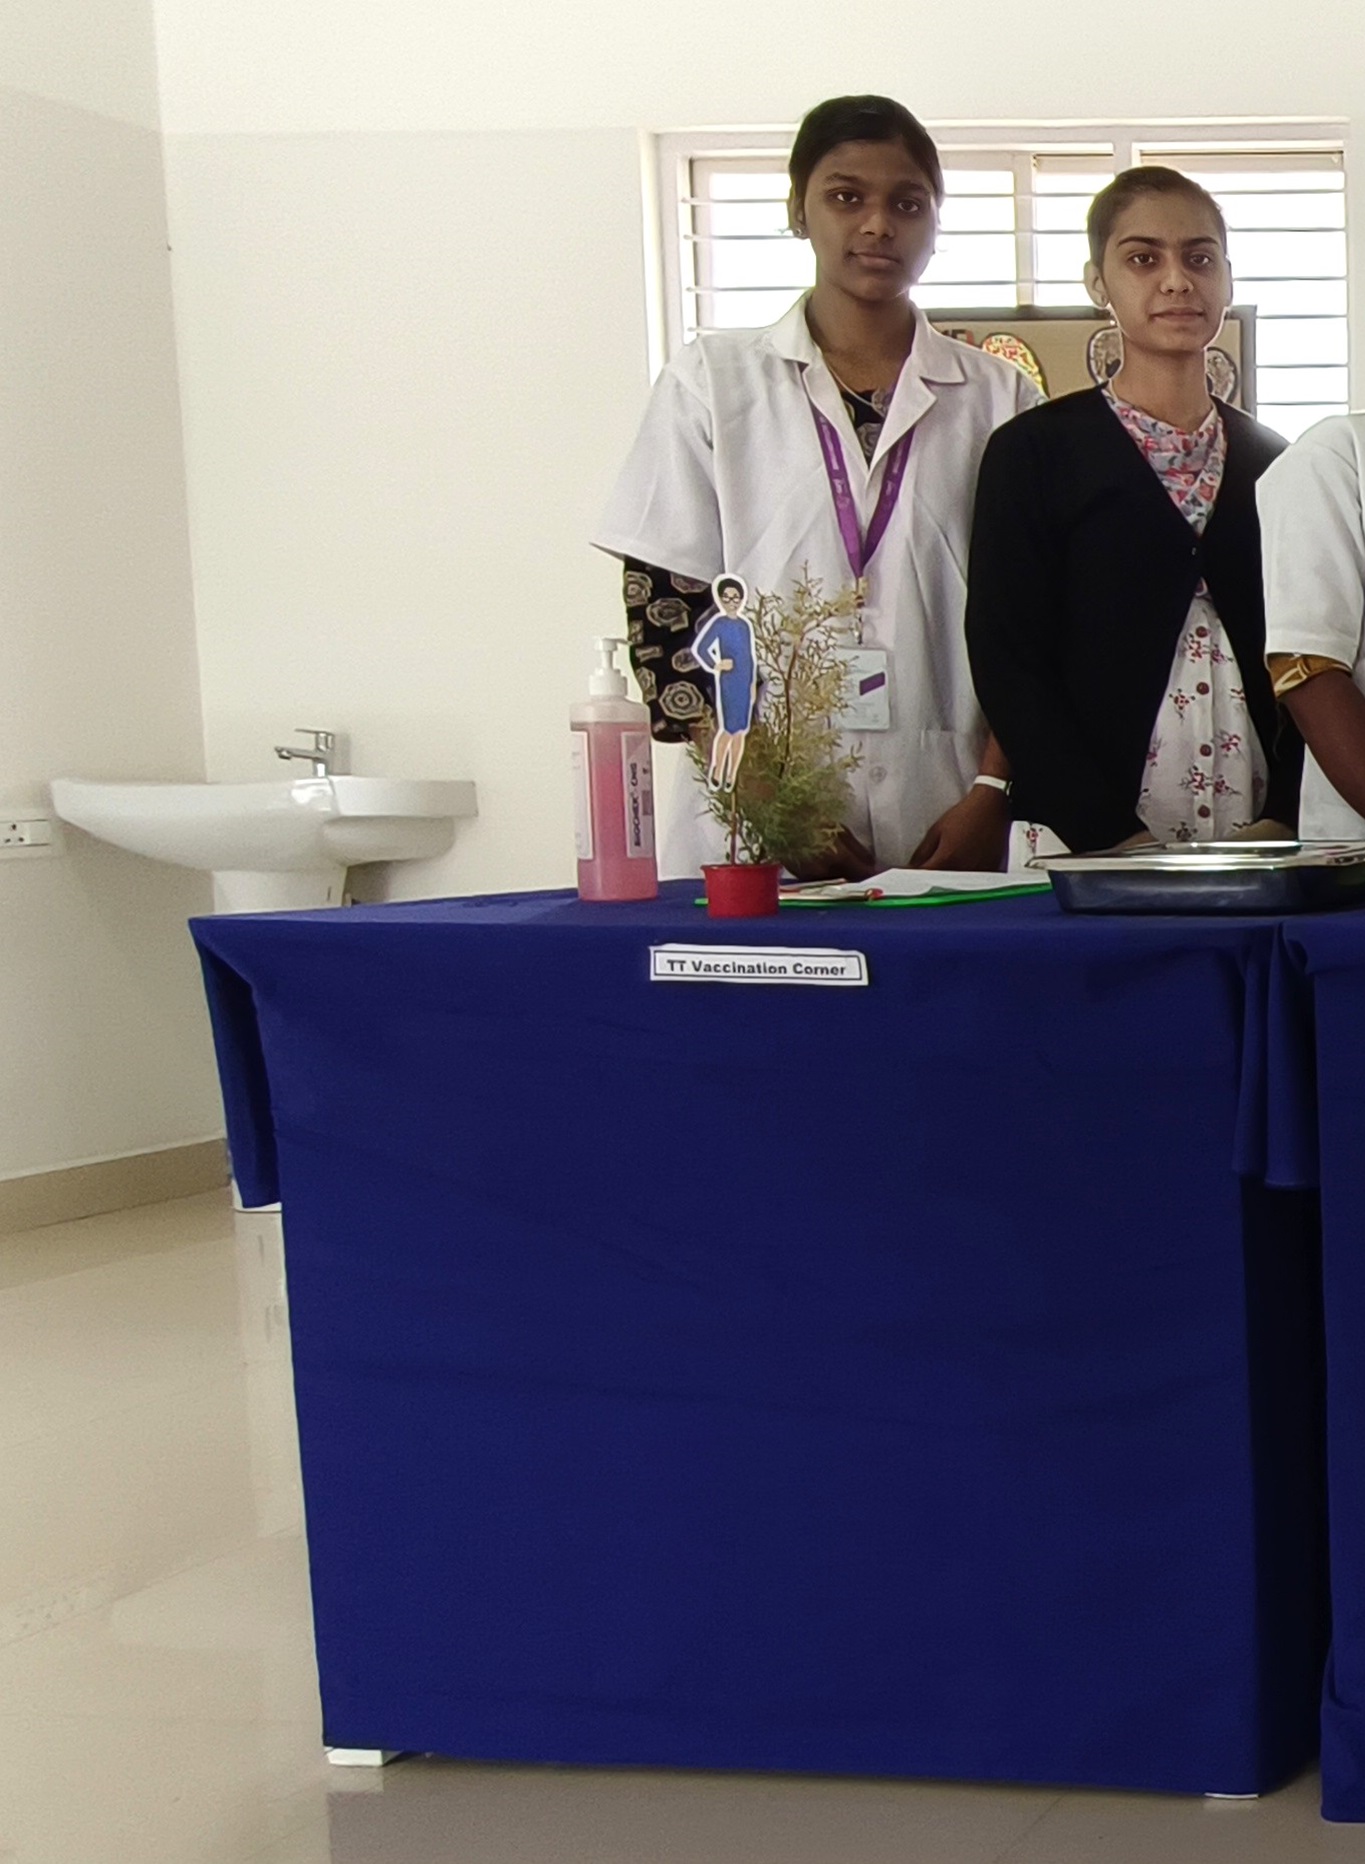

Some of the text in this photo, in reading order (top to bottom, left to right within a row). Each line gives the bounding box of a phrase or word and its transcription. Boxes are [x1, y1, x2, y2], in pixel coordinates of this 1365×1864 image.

[667, 959, 847, 976] TT Vaccination Corner
